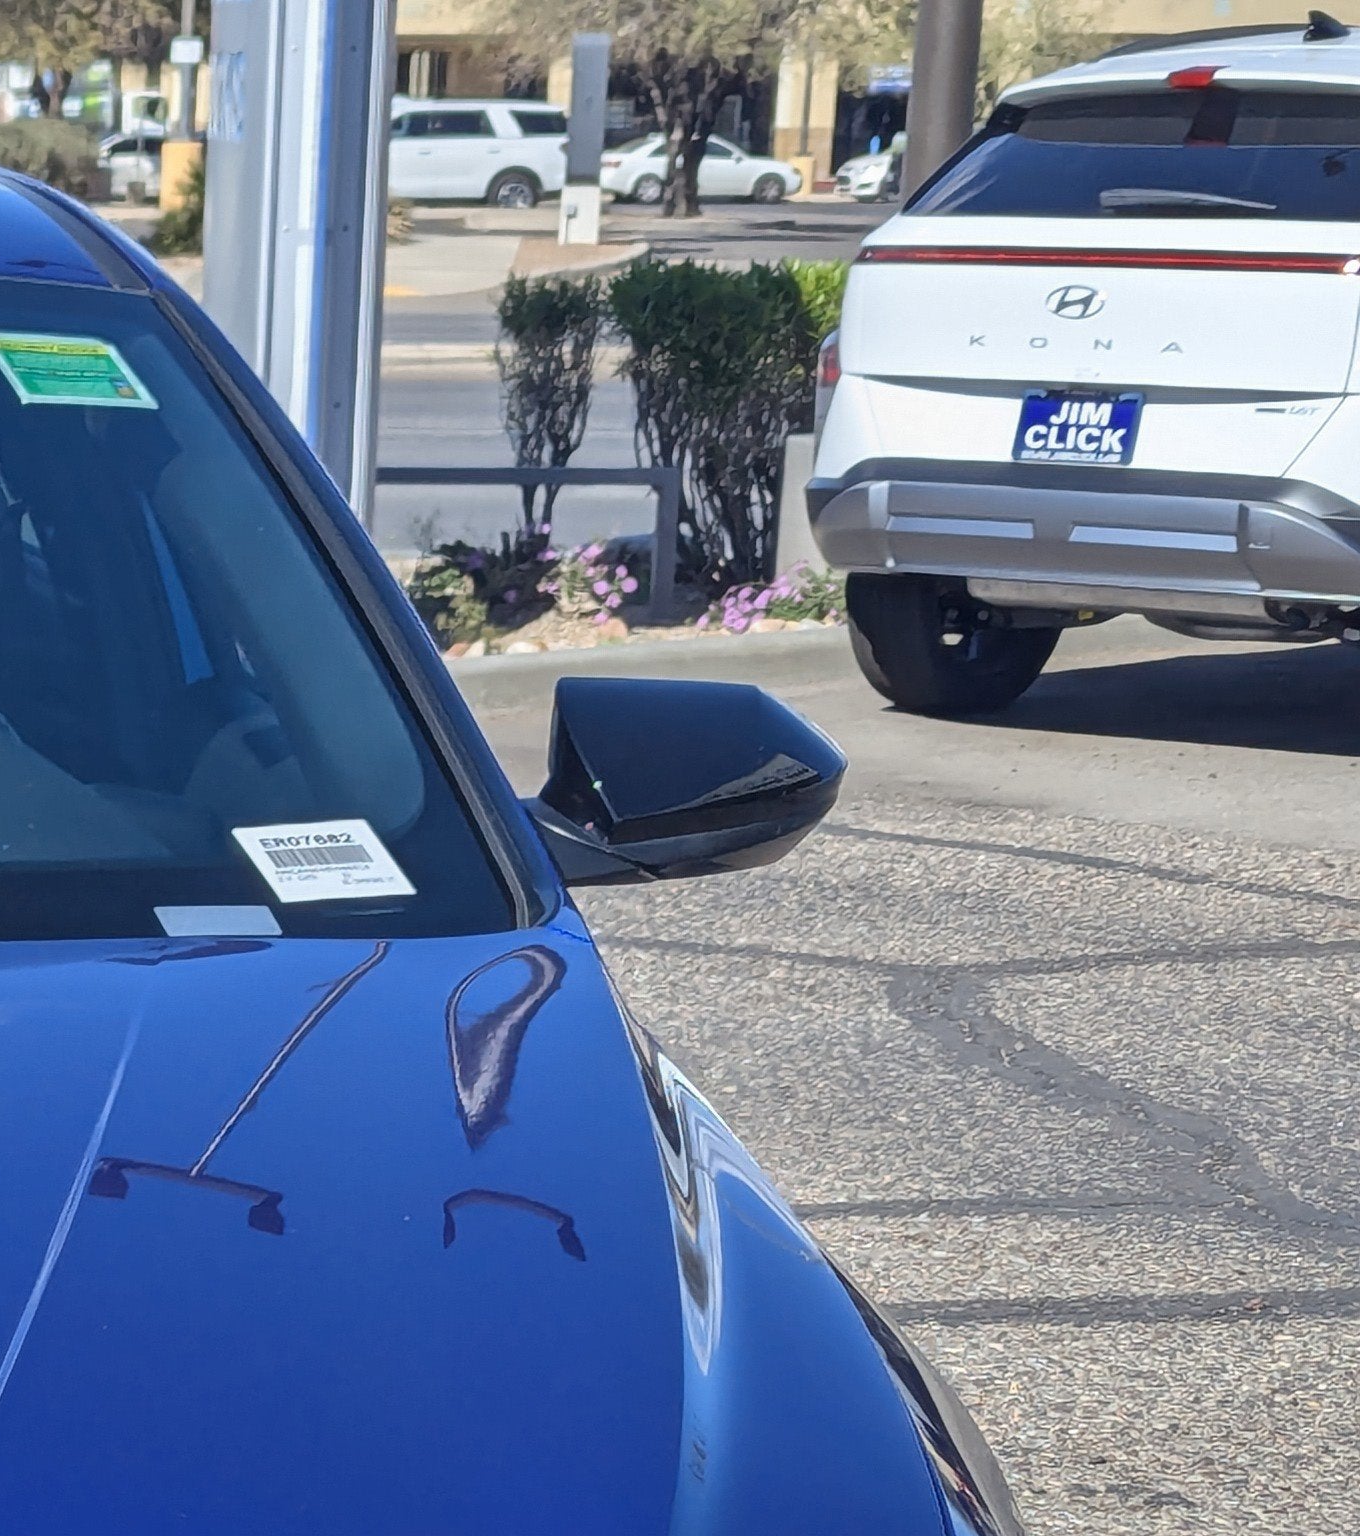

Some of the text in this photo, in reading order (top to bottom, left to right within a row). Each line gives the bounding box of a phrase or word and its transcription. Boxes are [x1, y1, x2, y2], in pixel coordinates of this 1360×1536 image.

[969, 334, 1184, 354] KONA
[1049, 401, 1113, 427] JIM
[1023, 424, 1127, 453] CLICK
